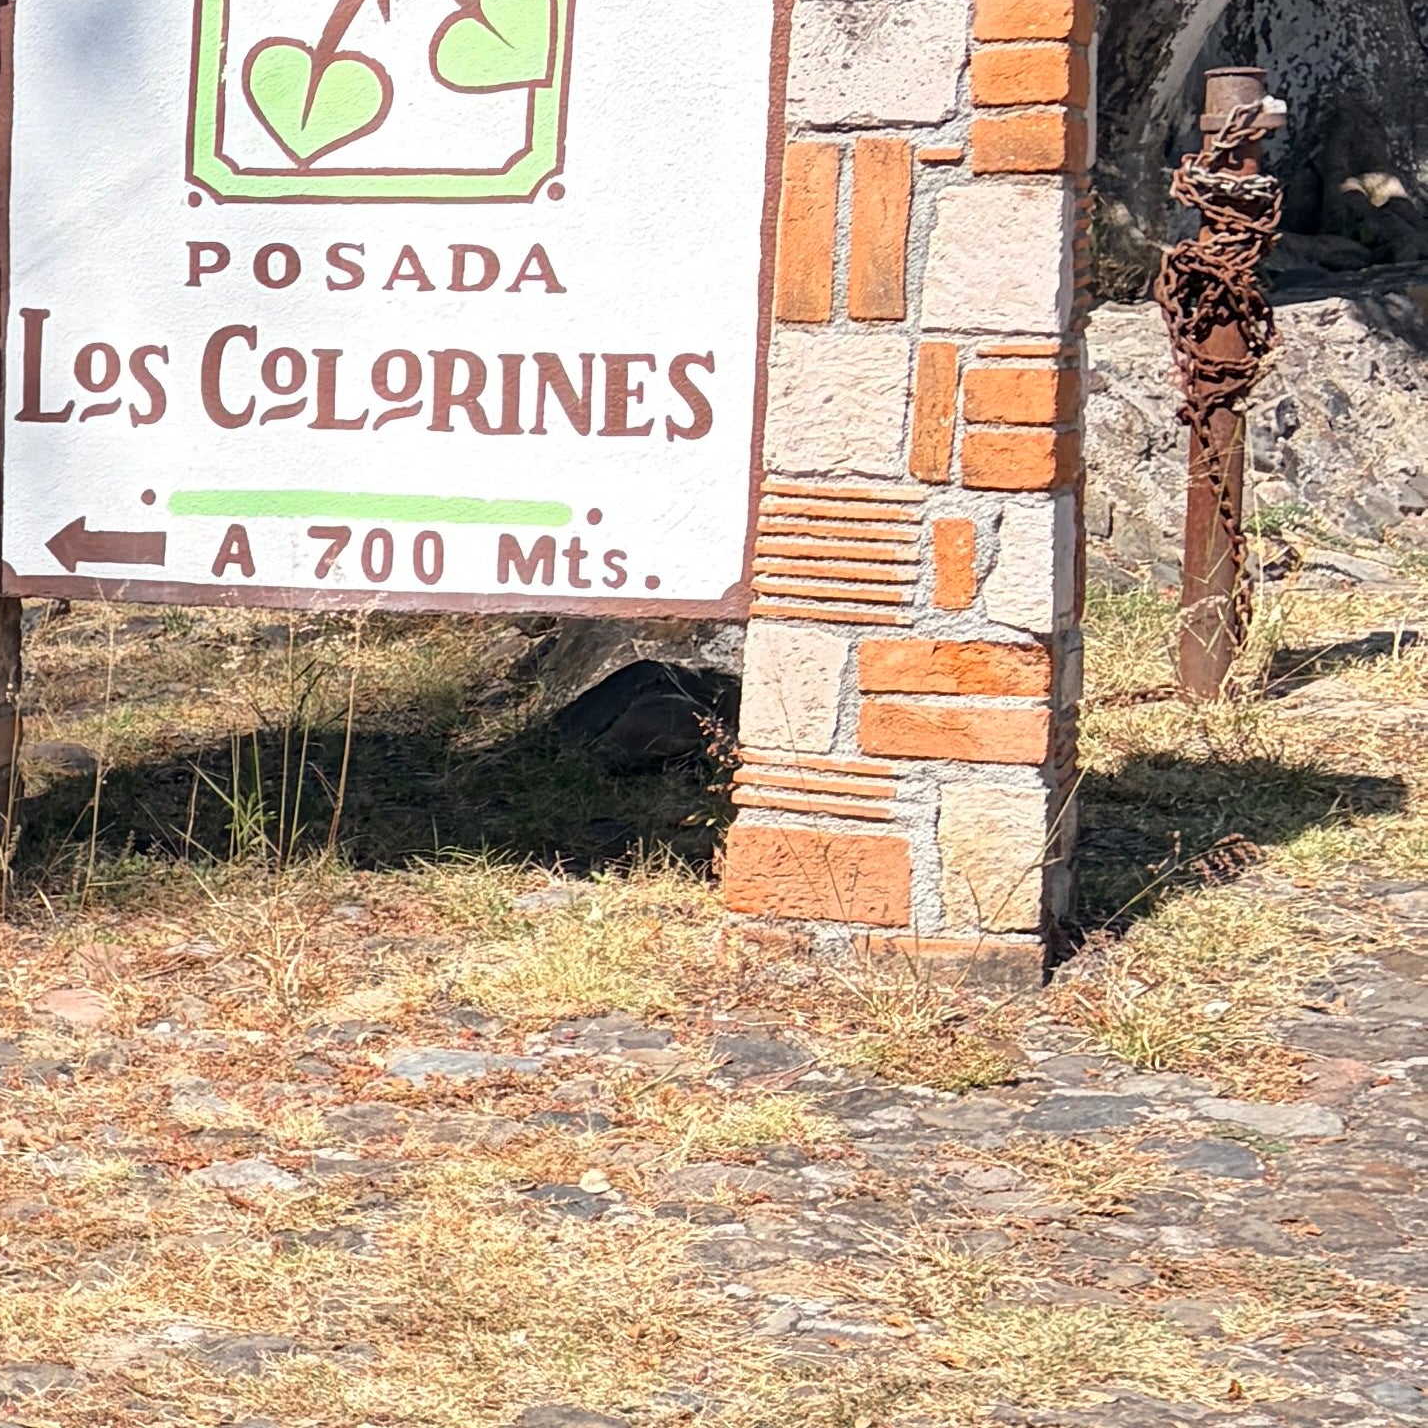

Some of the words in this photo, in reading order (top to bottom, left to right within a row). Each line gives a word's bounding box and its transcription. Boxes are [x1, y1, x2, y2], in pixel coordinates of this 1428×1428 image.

[184, 240, 567, 295] POSADA
[210, 523, 256, 579] A
[306, 524, 445, 586] 700
[496, 533, 662, 592] Mts.
